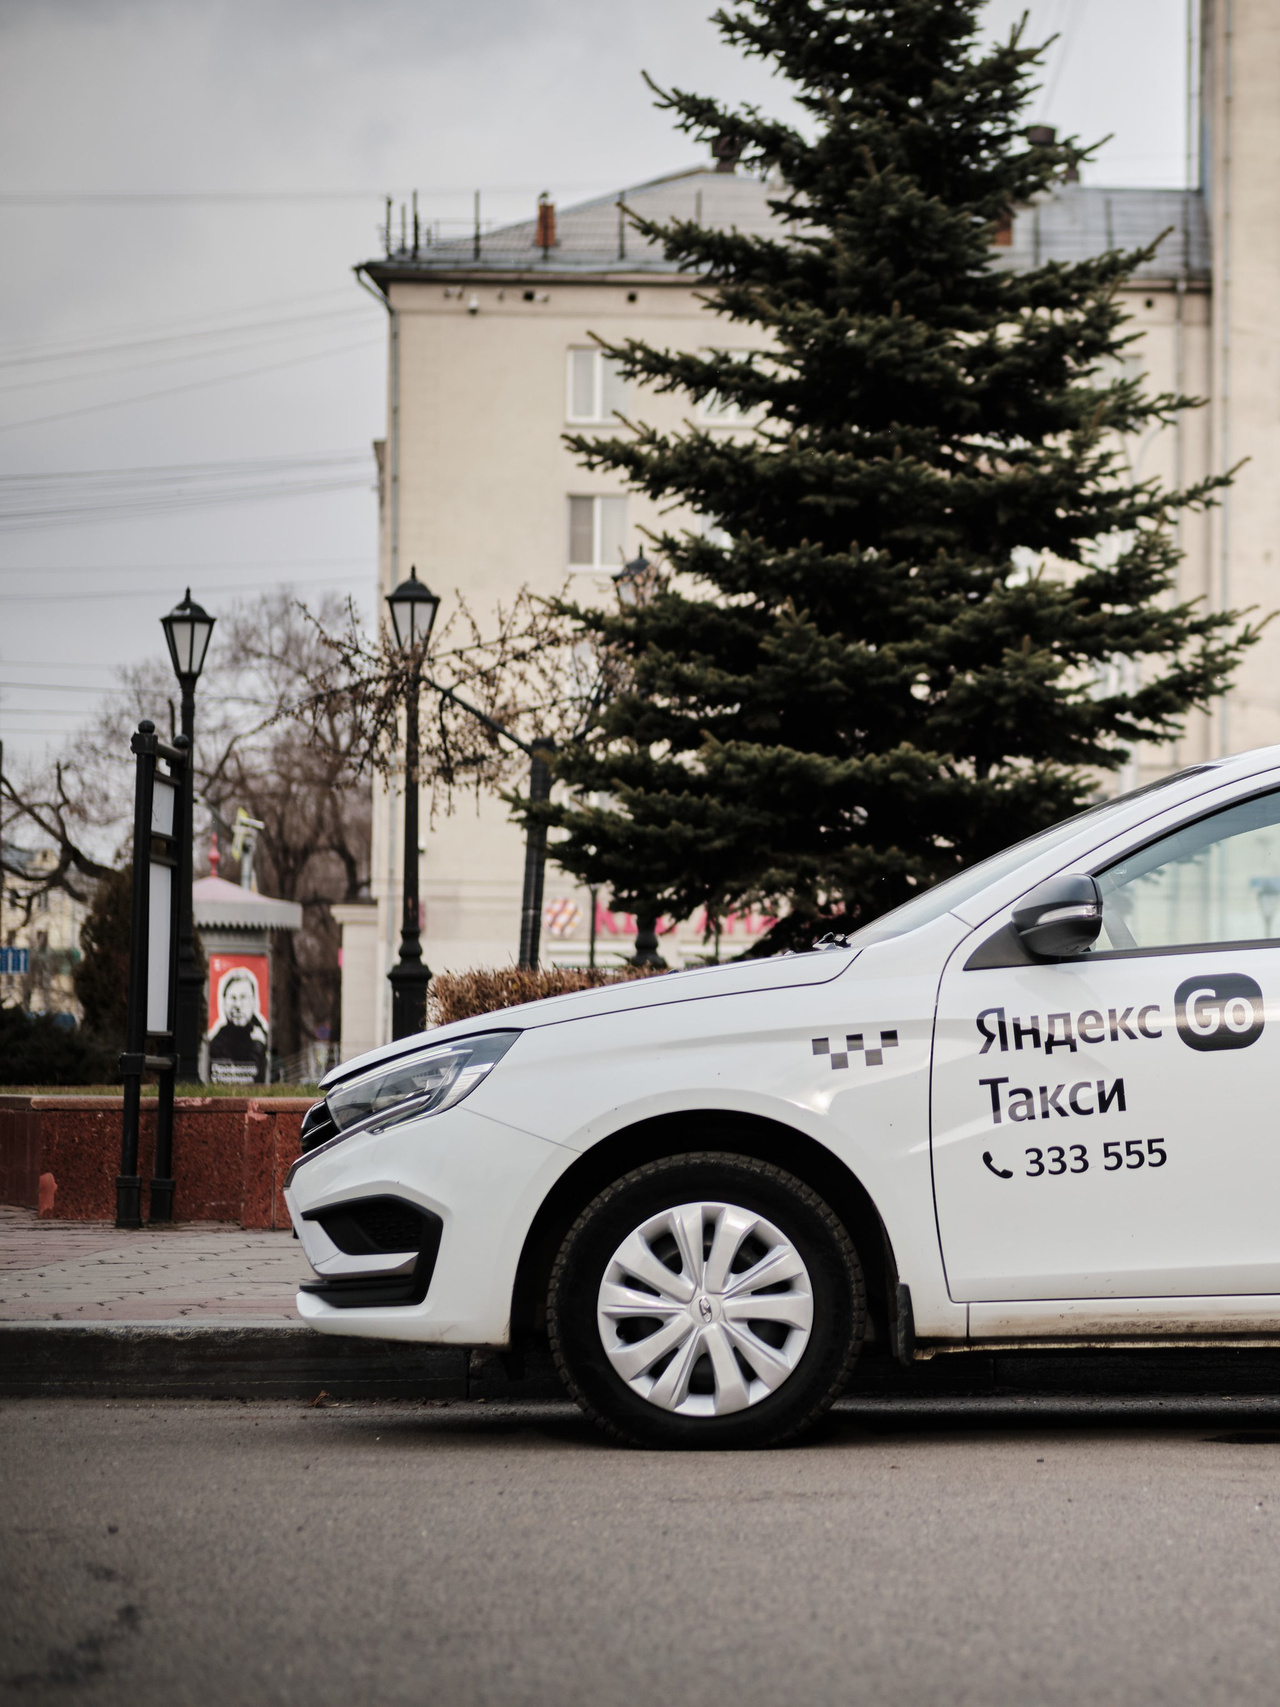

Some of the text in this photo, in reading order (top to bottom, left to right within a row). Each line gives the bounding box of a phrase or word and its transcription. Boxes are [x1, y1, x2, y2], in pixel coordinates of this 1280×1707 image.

[976, 988, 1255, 1055] Яндекс Go
[978, 1077, 1127, 1124] Такси
[1025, 1137, 1168, 1177] 333 555
